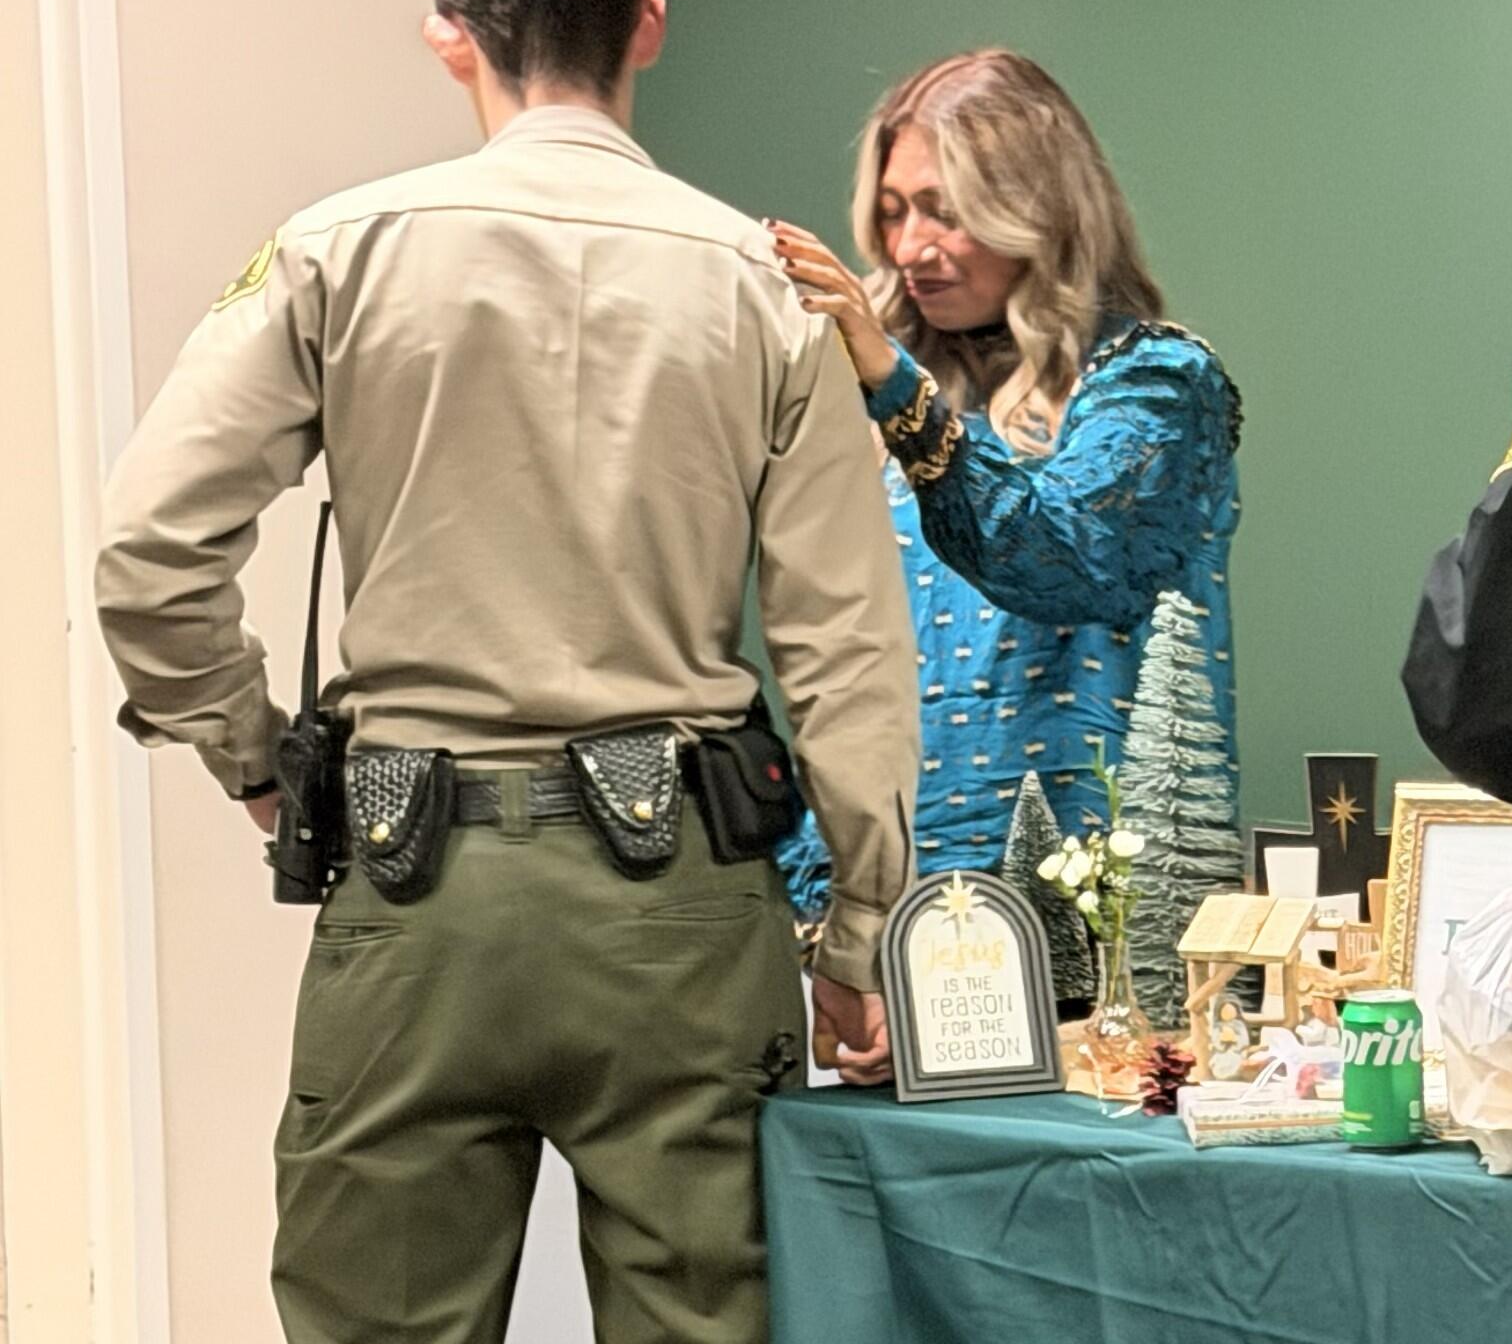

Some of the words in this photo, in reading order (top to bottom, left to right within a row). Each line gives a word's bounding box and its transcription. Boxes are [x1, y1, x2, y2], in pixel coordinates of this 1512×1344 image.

[943, 978, 960, 994] IS
[965, 975, 993, 992] THE
[940, 1020, 972, 1037] FOR
[978, 1017, 1006, 1034] THE
